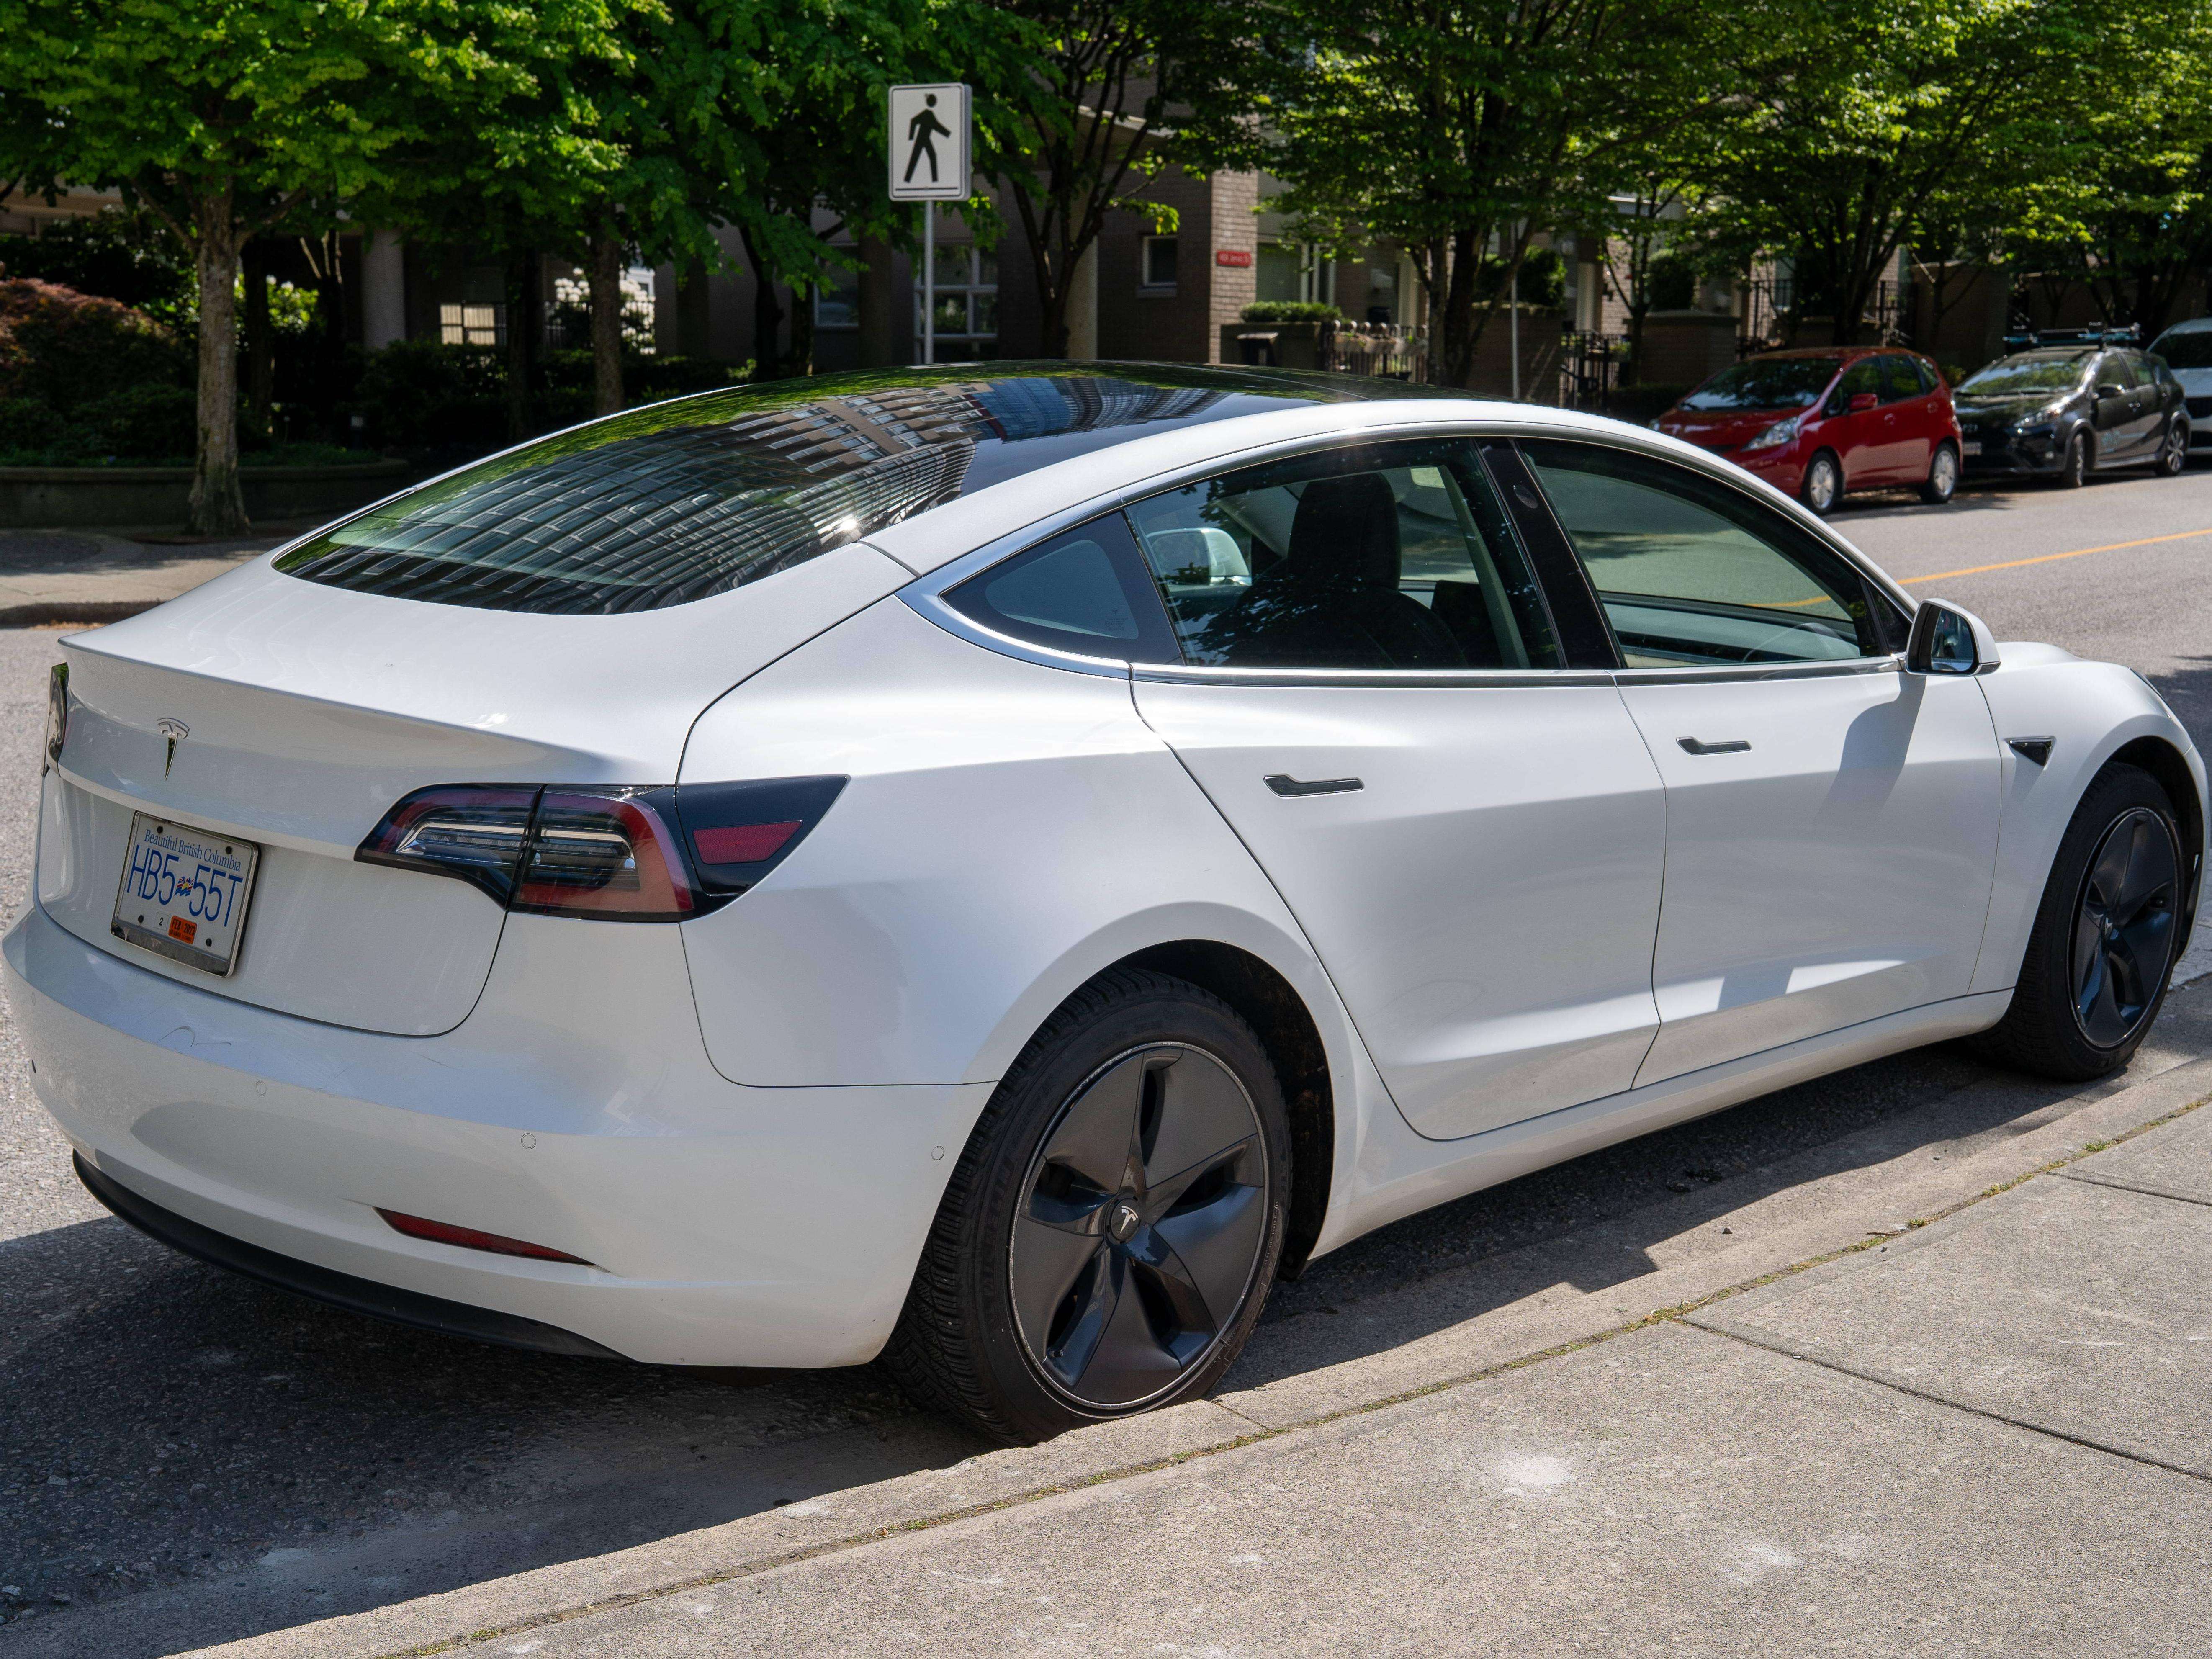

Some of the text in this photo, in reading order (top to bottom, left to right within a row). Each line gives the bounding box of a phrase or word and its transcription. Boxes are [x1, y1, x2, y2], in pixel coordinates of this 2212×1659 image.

[144, 829, 242, 872] Beautiful British Columbia
[126, 844, 243, 927] HB5 55T
[159, 917, 164, 926] 2
[172, 918, 182, 930] FEB
